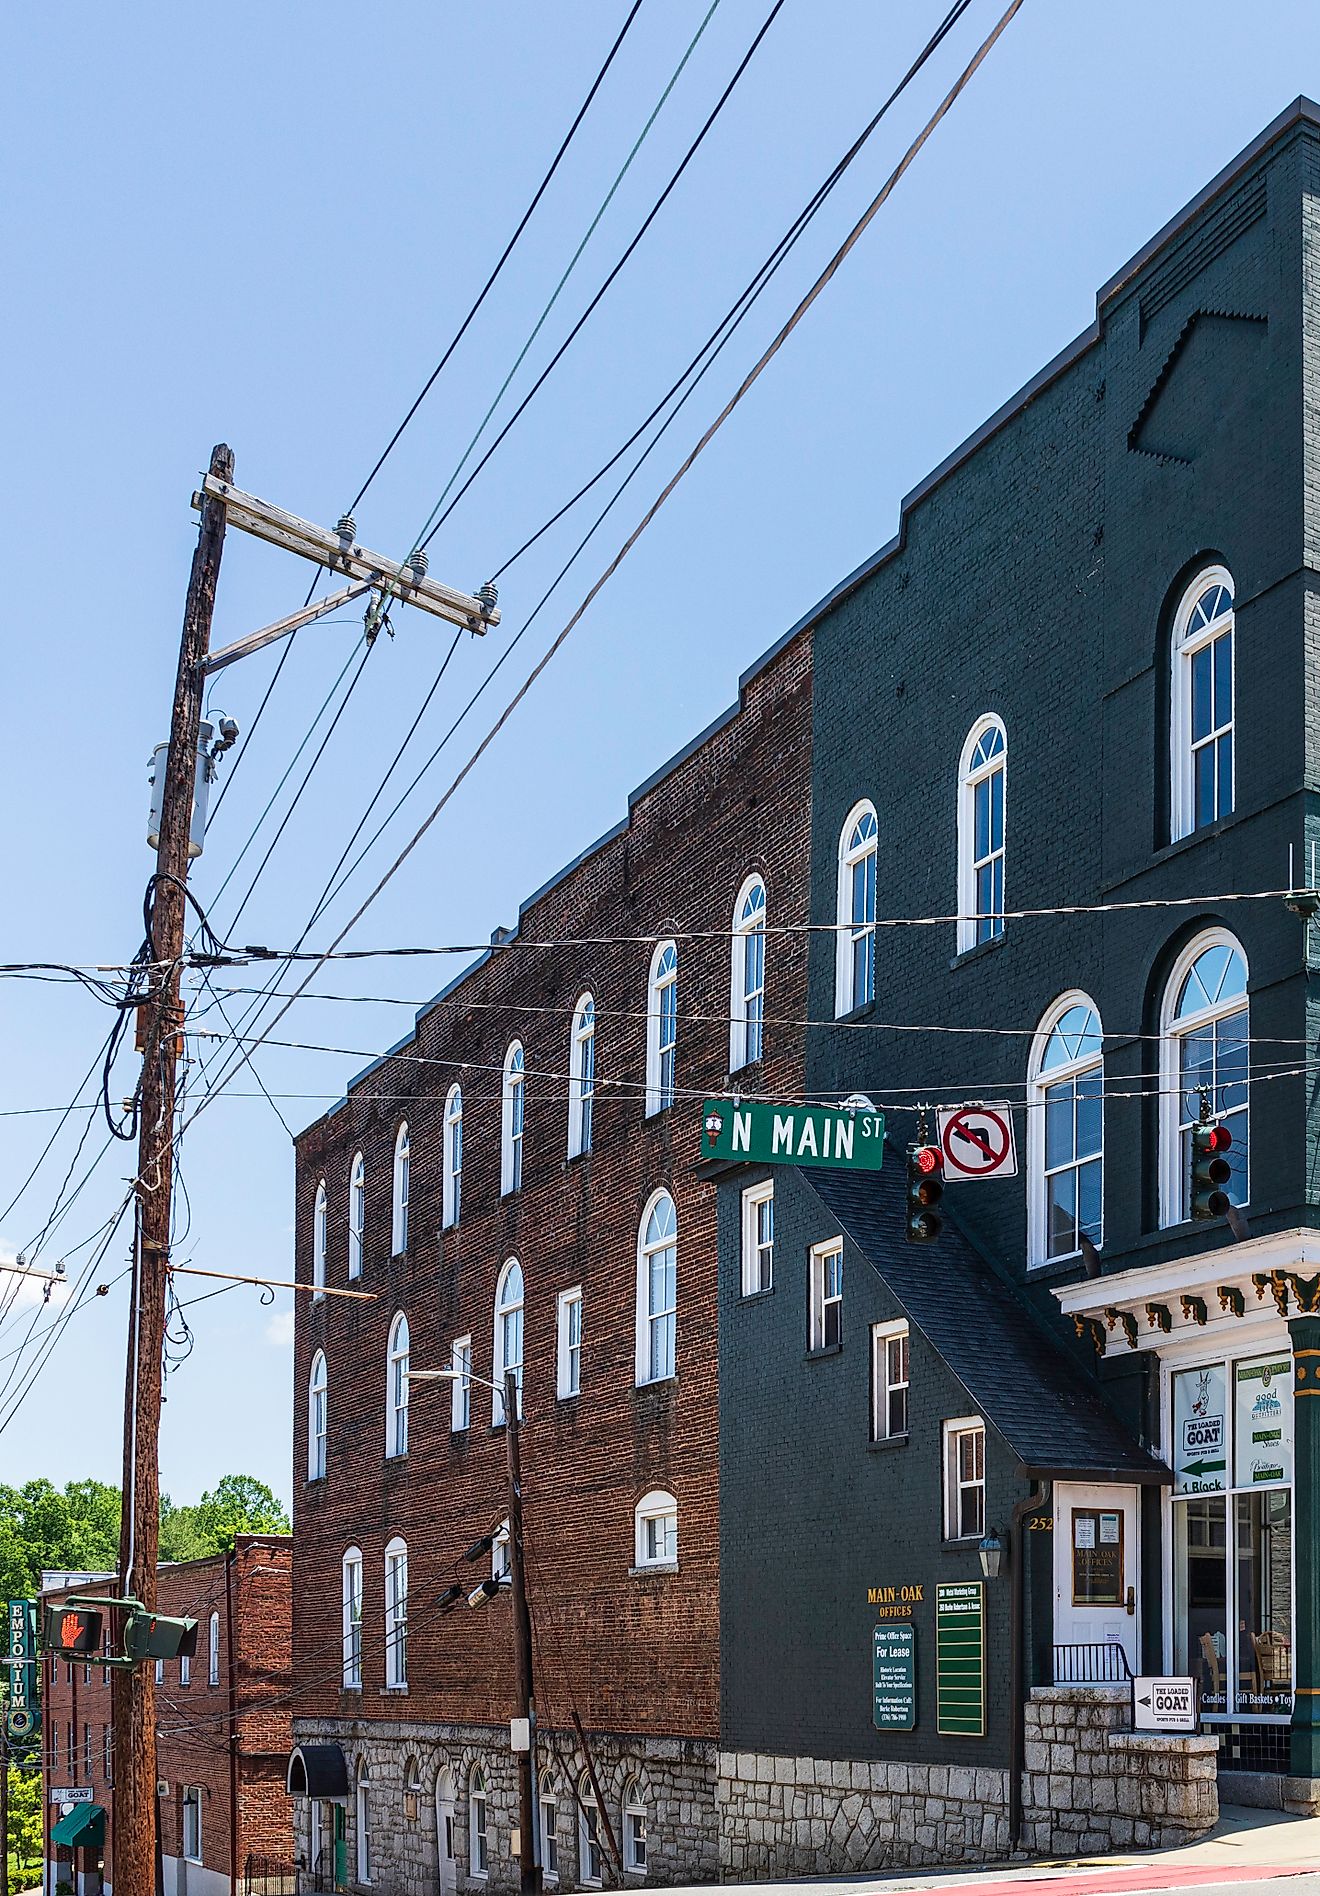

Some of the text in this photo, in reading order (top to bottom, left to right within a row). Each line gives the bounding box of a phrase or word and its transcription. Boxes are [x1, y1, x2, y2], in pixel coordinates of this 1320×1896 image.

[731, 1111, 881, 1159] N MAIN ST
[1256, 1389, 1276, 1401] good
[1198, 1420, 1220, 1429] LOADED
[1187, 1428, 1220, 1446] GOAT
[1183, 1479, 1222, 1494] 1 Block
[1029, 1518, 1053, 1530] 252
[868, 1585, 924, 1603] MAIN-OAK
[880, 1605, 912, 1617] OFFICES
[875, 1632, 886, 1640] Prime
[887, 1632, 899, 1640] Office
[12, 1605, 25, 1707] EMPORIUM
[876, 1646, 910, 1657] For Lease
[1156, 1696, 1189, 1711] GOAT
[1202, 1692, 1226, 1704] Candles
[1235, 1693, 1248, 1704] Gift
[1250, 1693, 1273, 1705] Baskets
